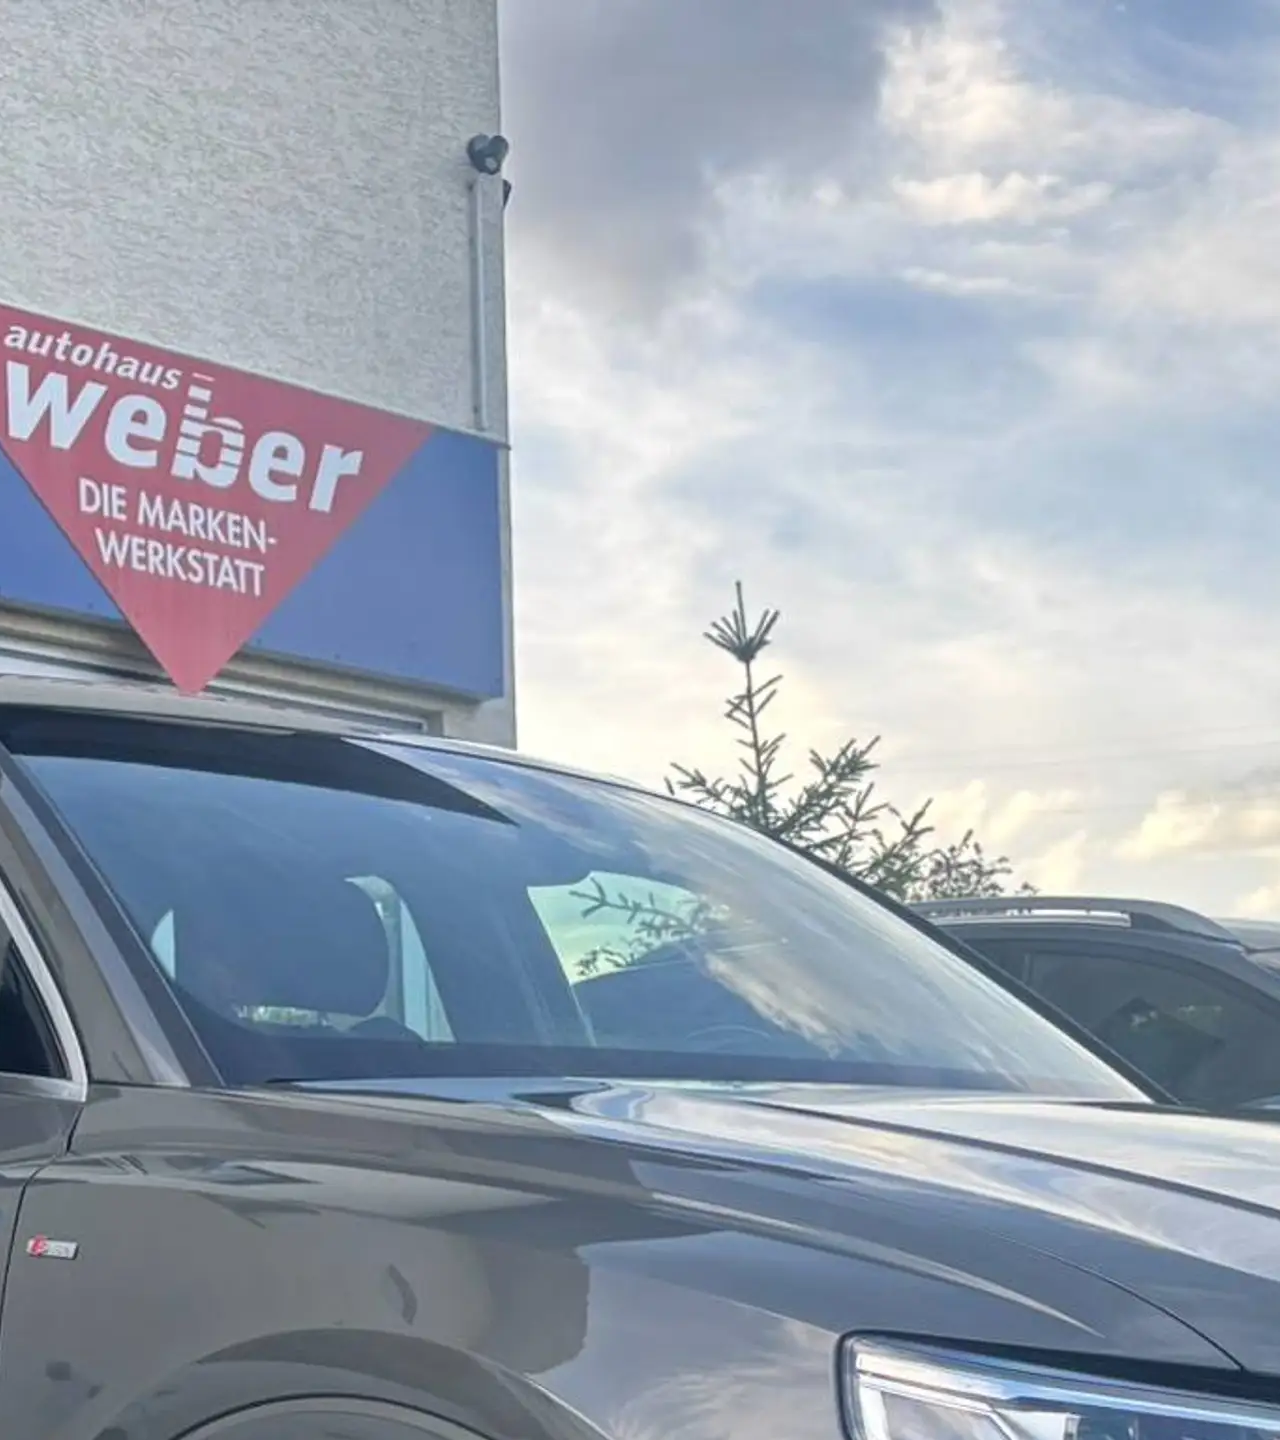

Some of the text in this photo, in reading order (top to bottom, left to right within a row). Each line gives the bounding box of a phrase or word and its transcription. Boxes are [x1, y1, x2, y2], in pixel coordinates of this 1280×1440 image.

[4, 325, 182, 389] autohaus
[6, 360, 363, 512] weber
[78, 477, 278, 553] DIE MARKEN-
[95, 527, 264, 596] WERKSTATT
